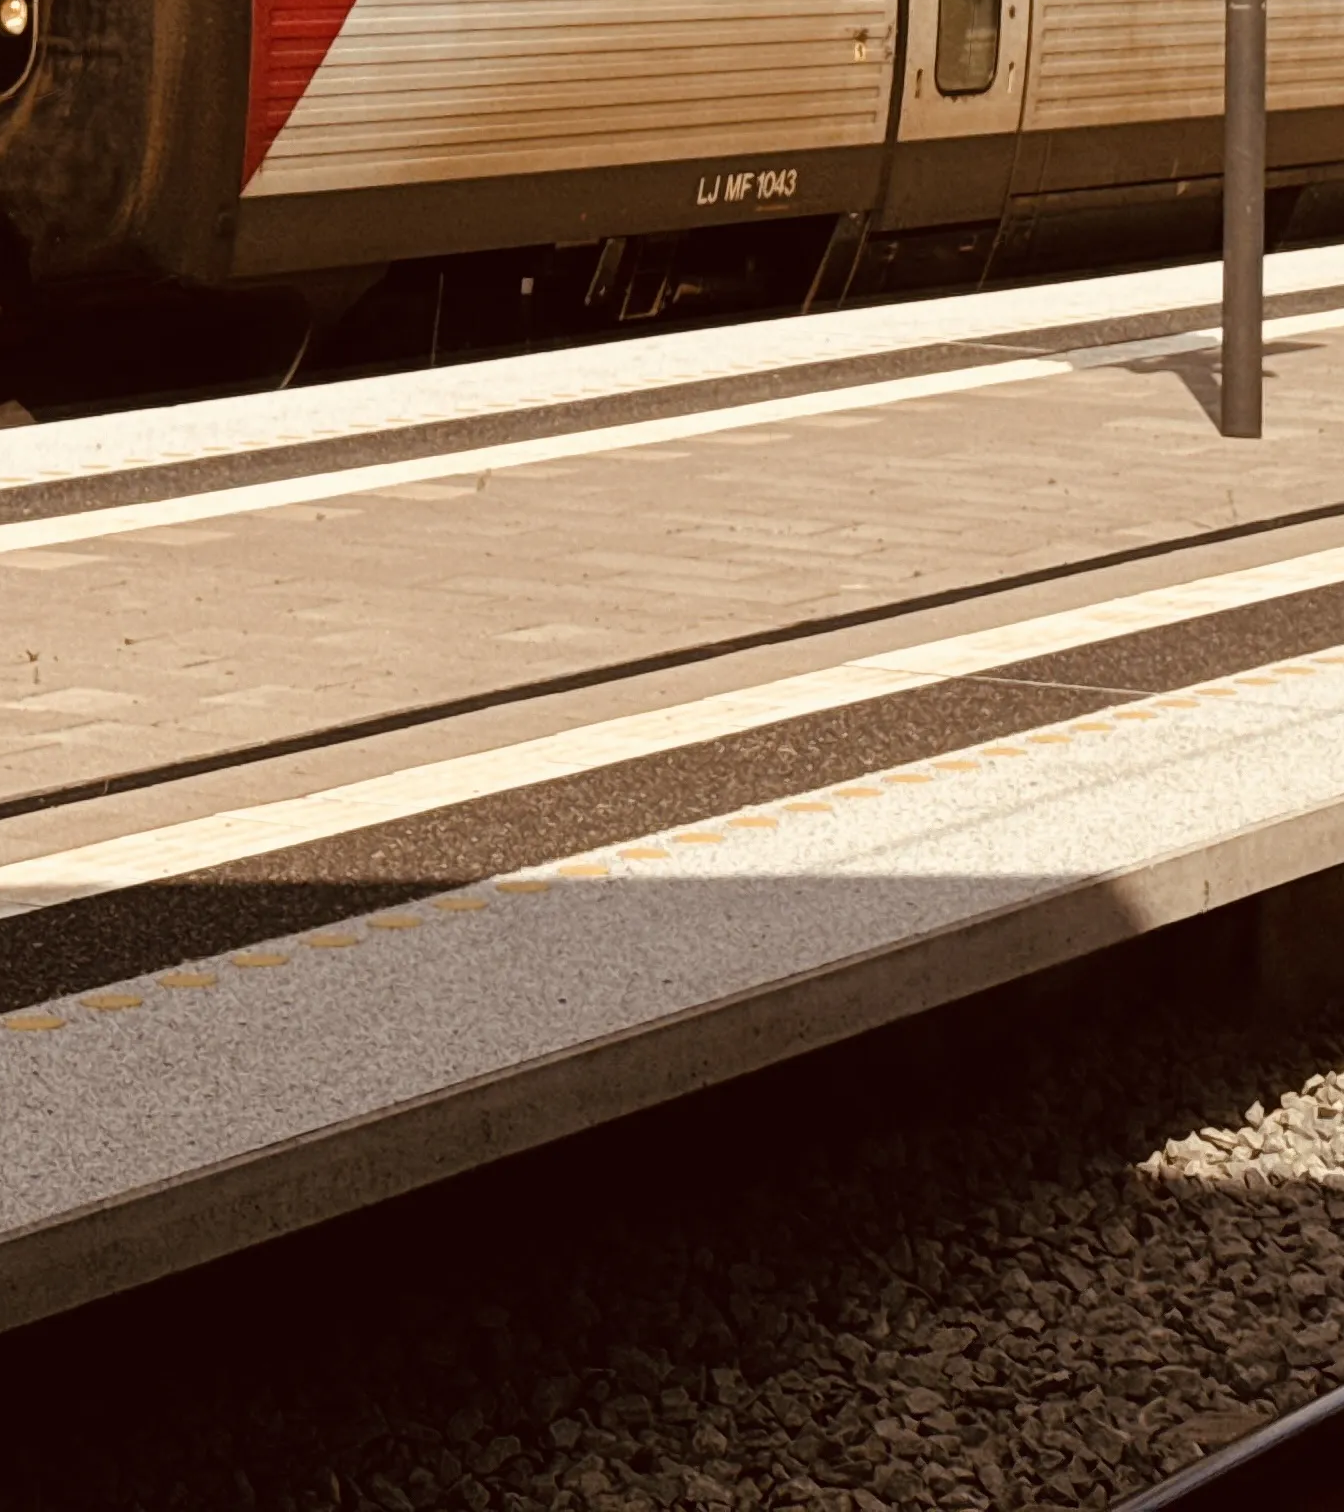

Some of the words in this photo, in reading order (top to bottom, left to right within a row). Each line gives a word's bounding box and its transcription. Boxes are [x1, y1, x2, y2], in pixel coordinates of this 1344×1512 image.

[696, 174, 721, 206] LJ
[724, 171, 755, 202] MF
[756, 167, 798, 200] 1043
